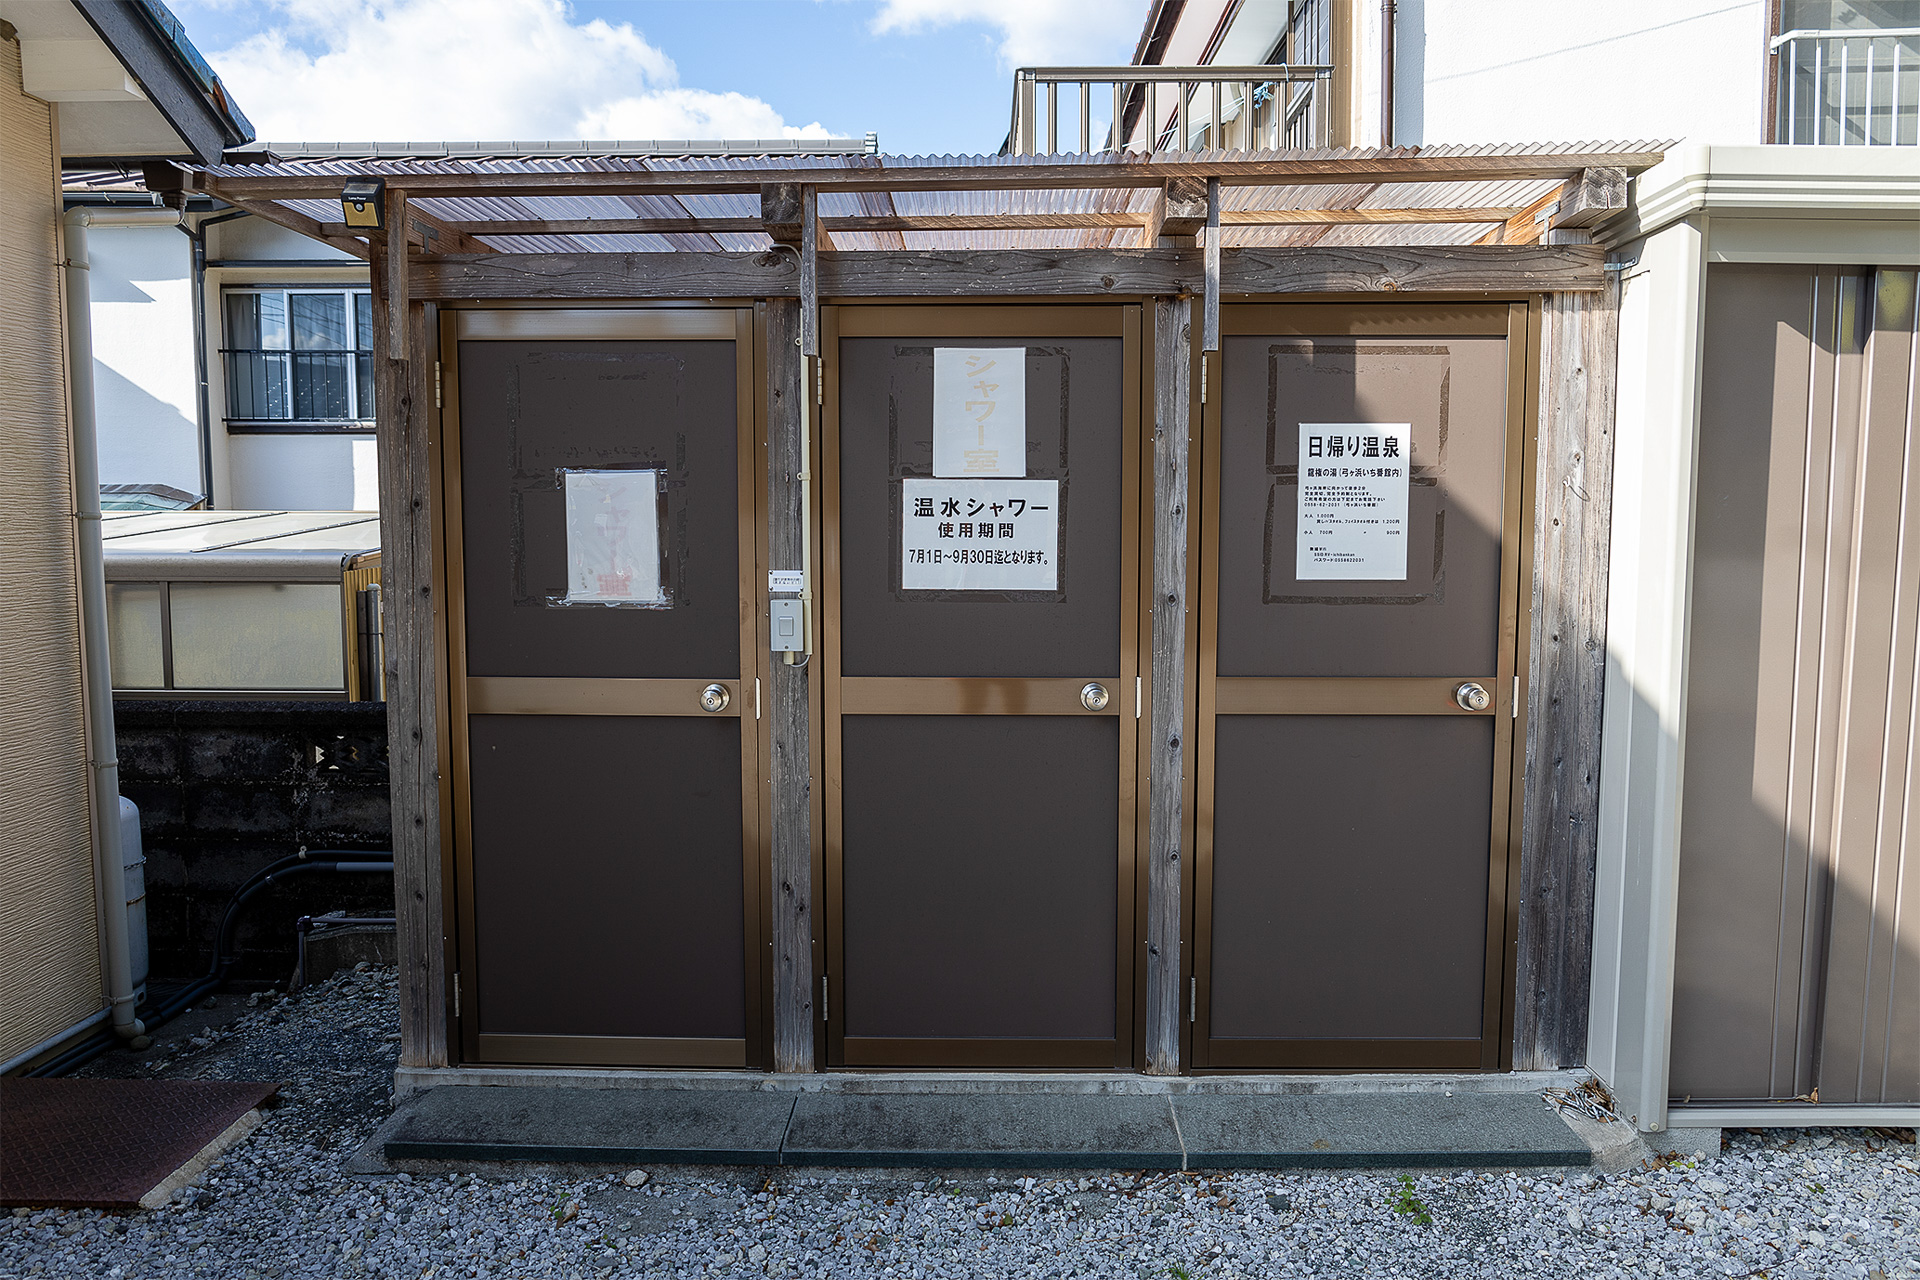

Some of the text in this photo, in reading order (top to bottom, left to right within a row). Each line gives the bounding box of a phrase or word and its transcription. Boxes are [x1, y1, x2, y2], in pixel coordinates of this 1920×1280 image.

[963, 354, 1000, 473] シャワー室
[1308, 435, 1400, 458] 日帰り温泉
[913, 497, 1049, 518] 温水シャワー
[937, 522, 1015, 539] 使用期間
[908, 549, 1049, 565] 7月1日～9月30日迄となります。
